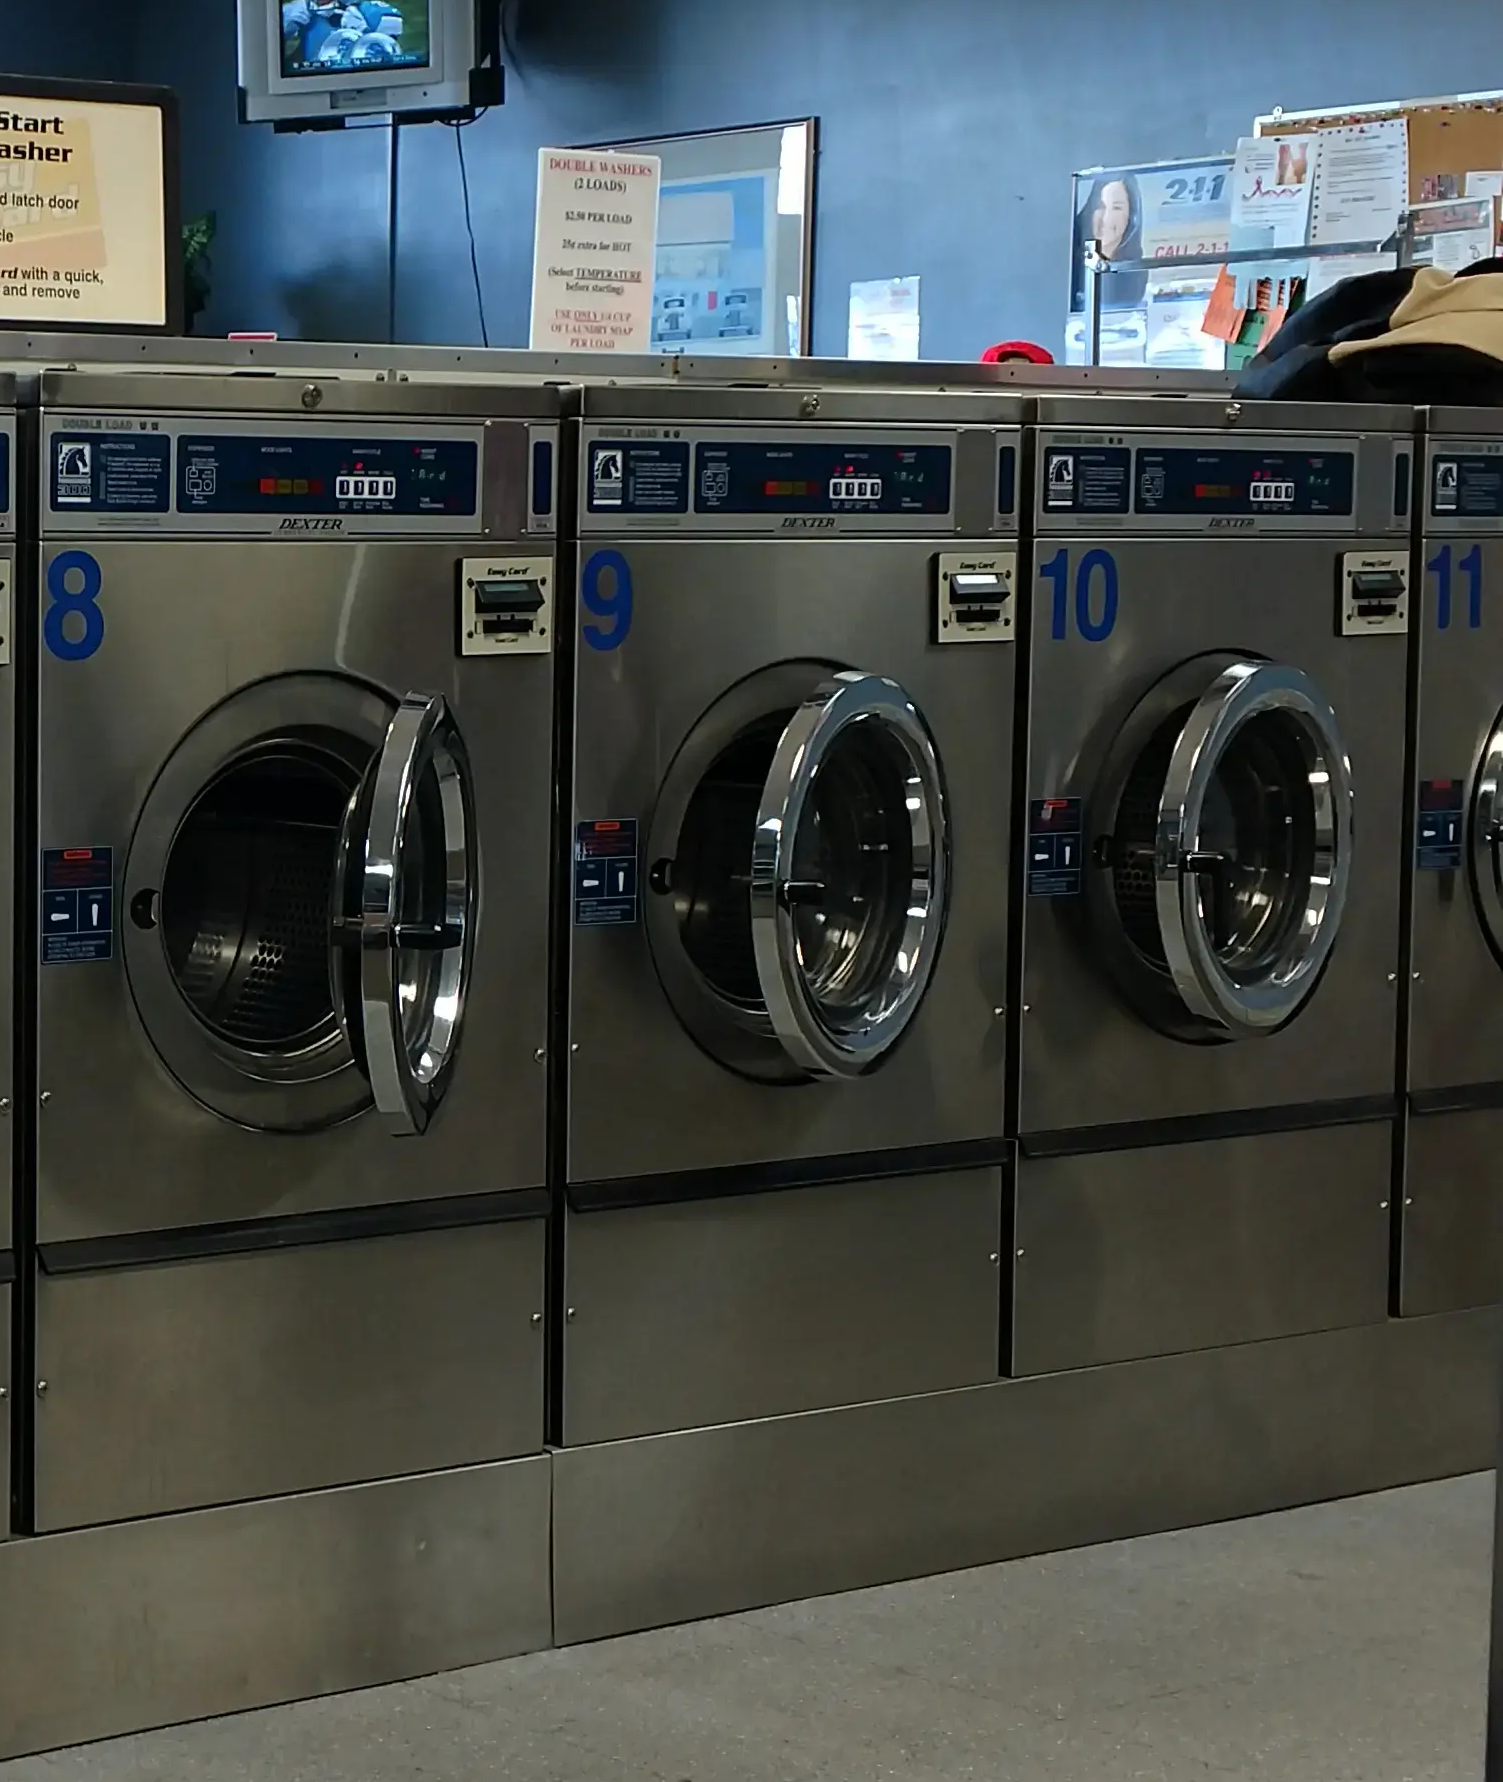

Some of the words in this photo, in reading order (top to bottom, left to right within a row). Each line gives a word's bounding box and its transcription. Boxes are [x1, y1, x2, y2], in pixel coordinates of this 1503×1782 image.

[550, 158, 596, 172] DOUBLE
[599, 161, 652, 176] WASHERS
[587, 178, 627, 195] LOADS)
[12, 191, 44, 209] latch
[49, 194, 79, 210] door
[21, 267, 48, 281] with
[53, 271, 60, 282] a
[65, 269, 104, 285] quick,
[2, 282, 27, 297] and
[32, 285, 81, 300] remove
[279, 519, 343, 530] DEXTER
[1040, 548, 1118, 642] 10
[1427, 545, 1481, 629] 11
[44, 550, 104, 660] 8
[582, 549, 632, 651] 9
